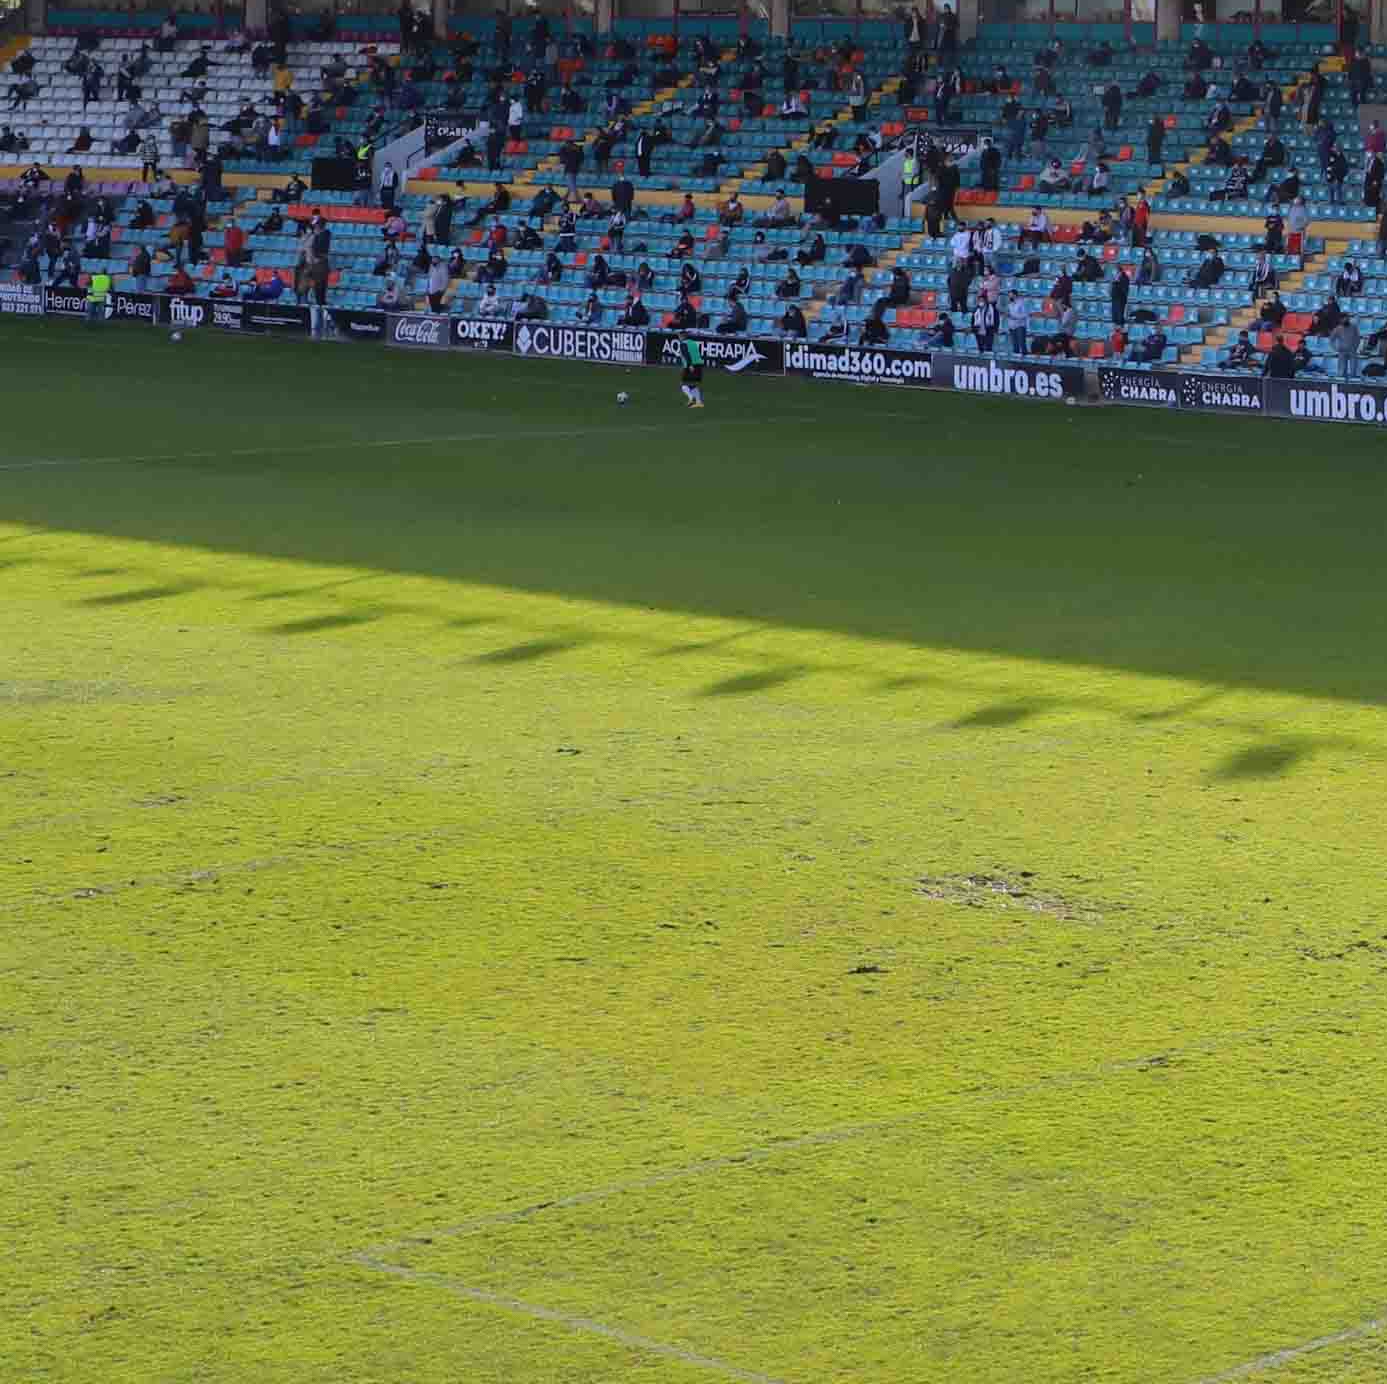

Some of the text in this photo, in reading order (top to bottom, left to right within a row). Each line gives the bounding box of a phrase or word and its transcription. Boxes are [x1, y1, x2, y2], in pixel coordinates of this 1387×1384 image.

[457, 320, 507, 340] OKEY!
[533, 327, 611, 360] CUBERS
[612, 332, 643, 351] HIELO
[785, 344, 931, 378] idimad360.com
[954, 360, 1063, 398] umbro.es
[1120, 385, 1176, 401] CHARRA
[1202, 392, 1261, 408] CHARRA
